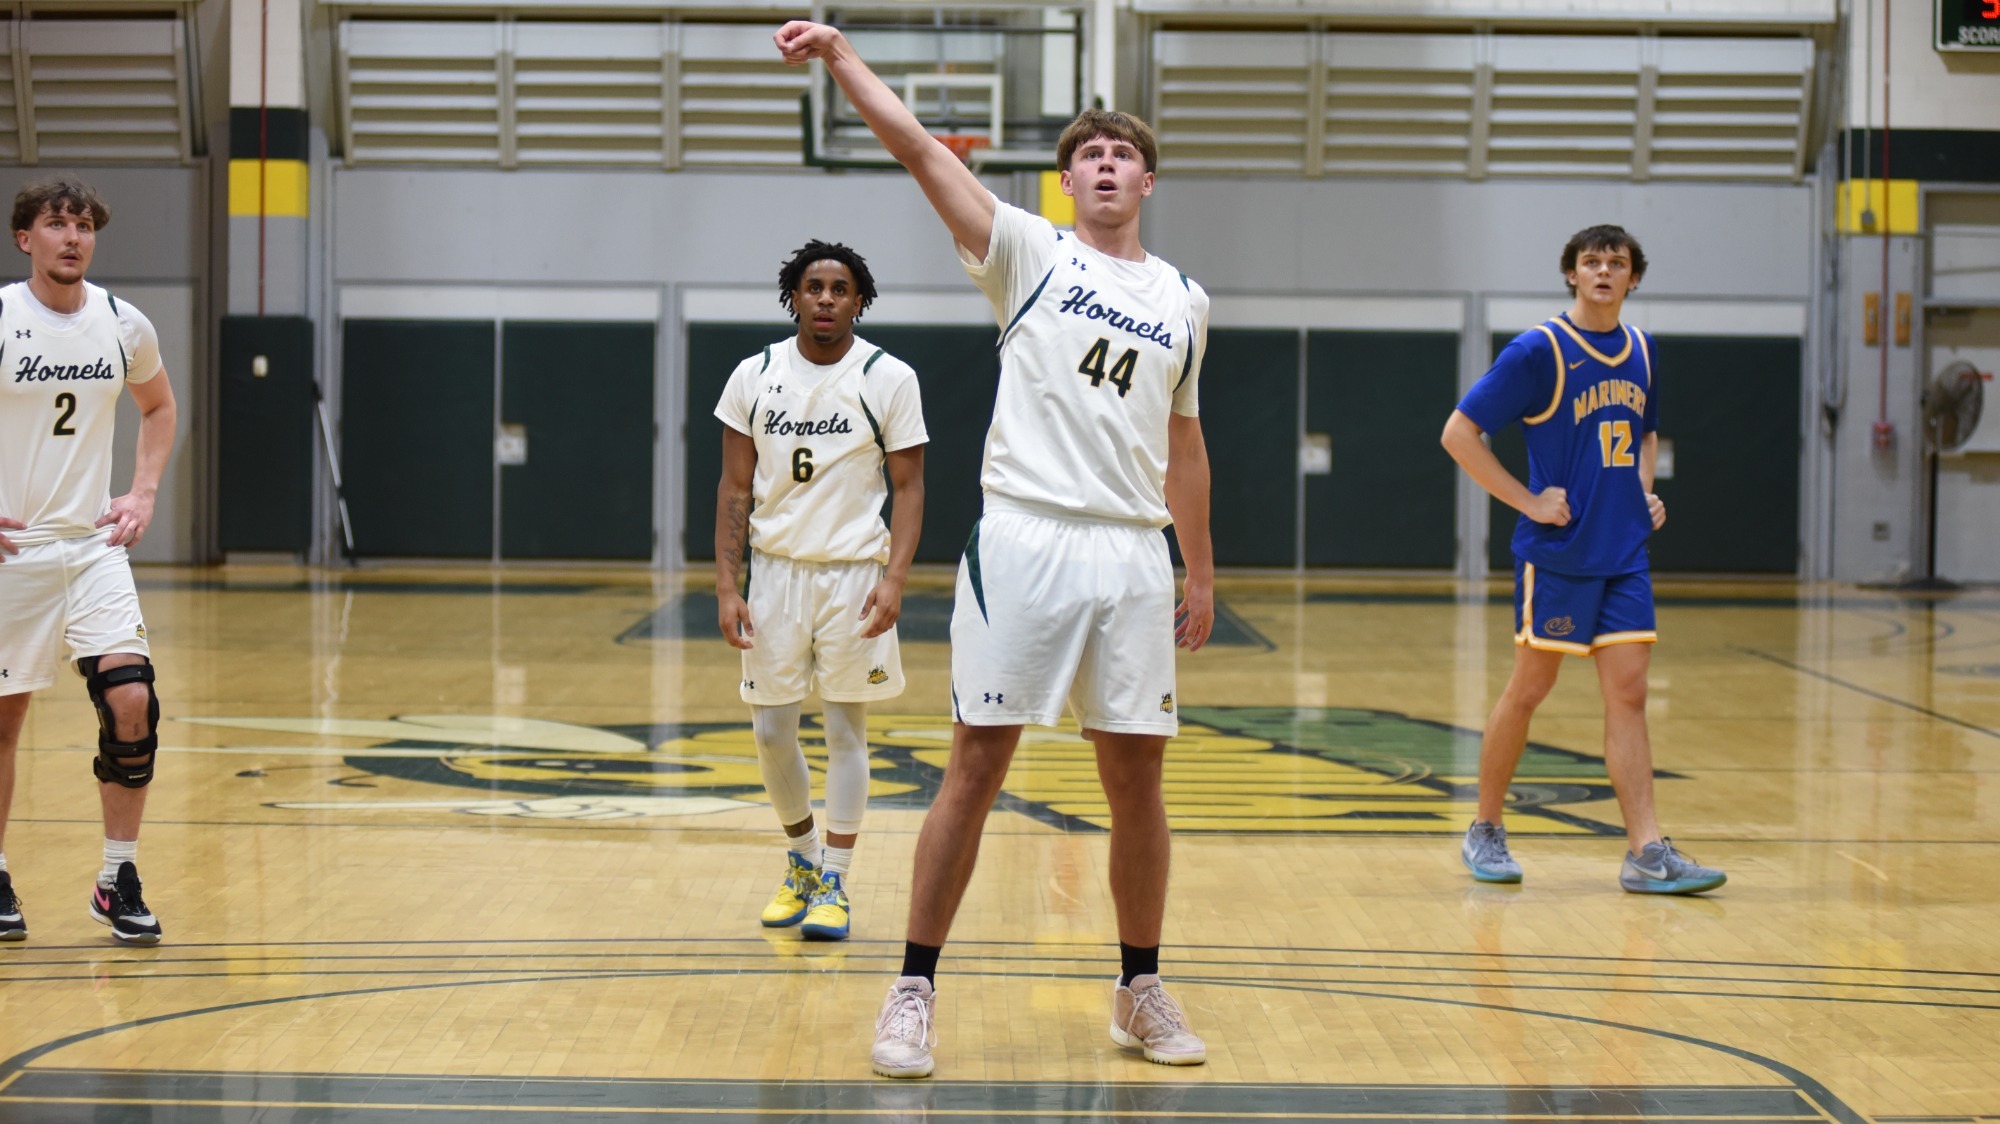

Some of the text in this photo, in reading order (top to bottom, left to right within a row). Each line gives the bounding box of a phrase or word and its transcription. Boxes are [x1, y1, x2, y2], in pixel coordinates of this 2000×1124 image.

[1958, 25, 2000, 44] SCOR
[1059, 285, 1172, 349] Hornets
[15, 354, 115, 383] Hornets
[1077, 337, 1139, 398] 44
[53, 392, 76, 436] 2
[764, 409, 852, 436] Hornets
[1598, 420, 1635, 468] 12
[792, 446, 814, 484] 6
